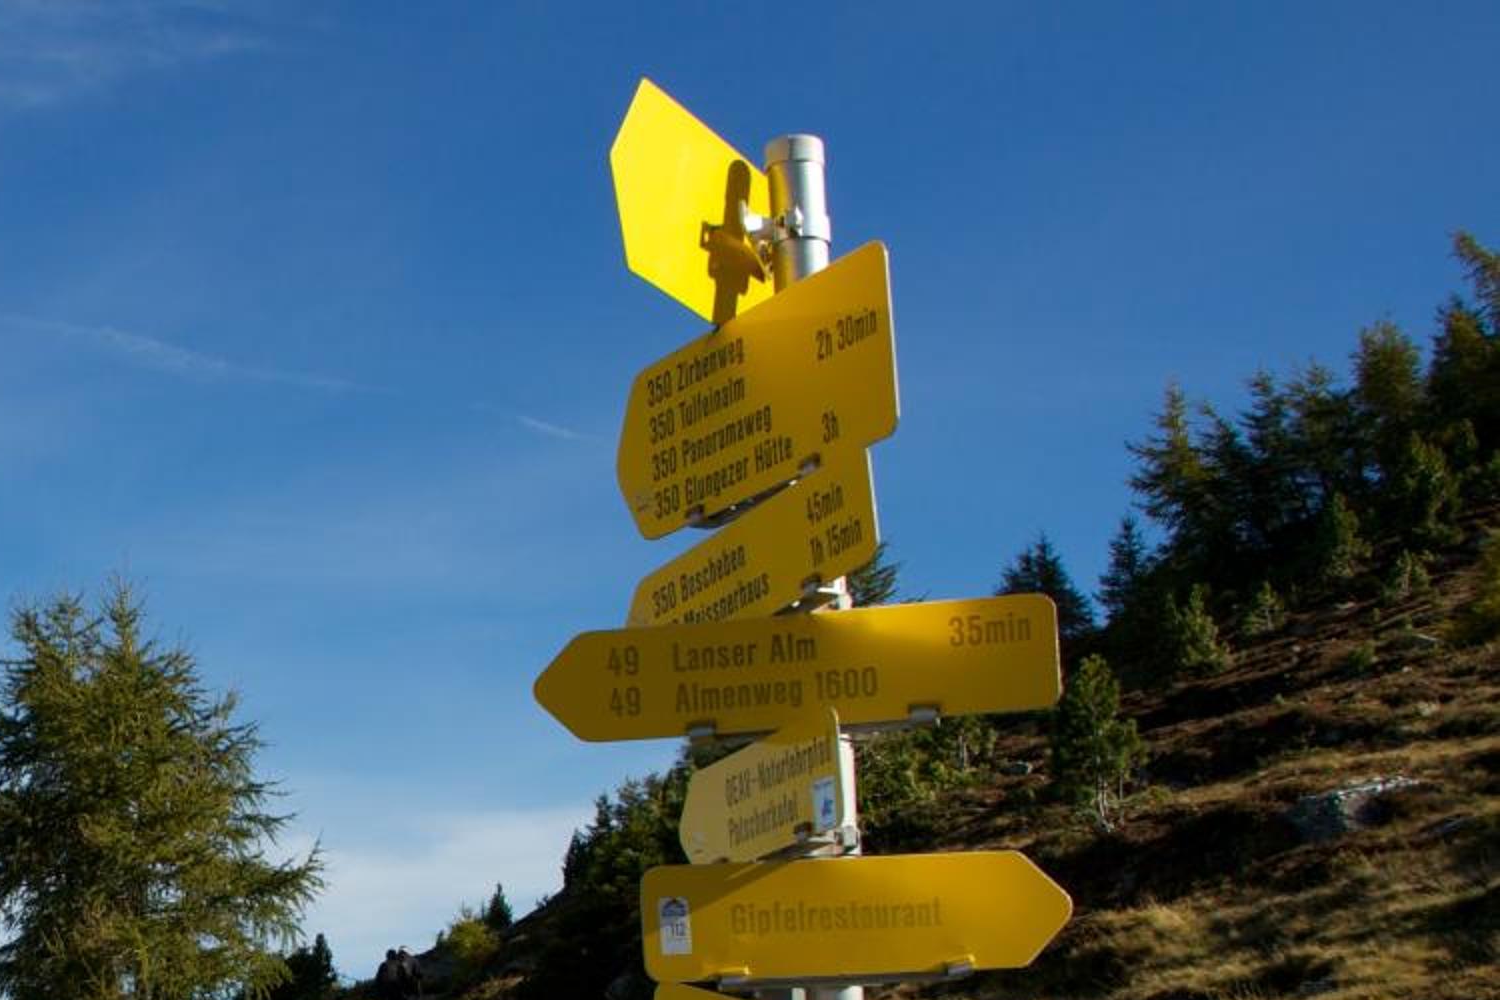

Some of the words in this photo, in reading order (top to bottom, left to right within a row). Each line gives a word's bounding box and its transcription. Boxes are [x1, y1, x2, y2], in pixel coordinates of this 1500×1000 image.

[815, 328, 833, 360] 2h
[836, 307, 877, 350] 30min
[647, 369, 673, 407] 350
[676, 338, 745, 391] Zirbenweg
[649, 408, 676, 444] 350
[679, 376, 746, 429] Tulfeinalm
[821, 410, 839, 443] 3h
[652, 446, 677, 482] 350
[681, 405, 772, 468] Panoramaweg
[654, 484, 680, 520] 350
[684, 457, 749, 505] Glungezer
[754, 436, 794, 474] Hütte
[807, 484, 844, 526] 45min
[810, 537, 824, 568] 1h
[827, 517, 863, 558] 15min
[652, 580, 677, 618] 350
[606, 645, 640, 676] 49
[672, 641, 757, 673] Lanser
[770, 632, 816, 664] Alm
[948, 611, 1031, 647] 35min
[610, 686, 642, 716] 49
[675, 680, 803, 713] Almenweg
[814, 665, 878, 700] 1600
[730, 897, 944, 936] Gipfelrestaurant
